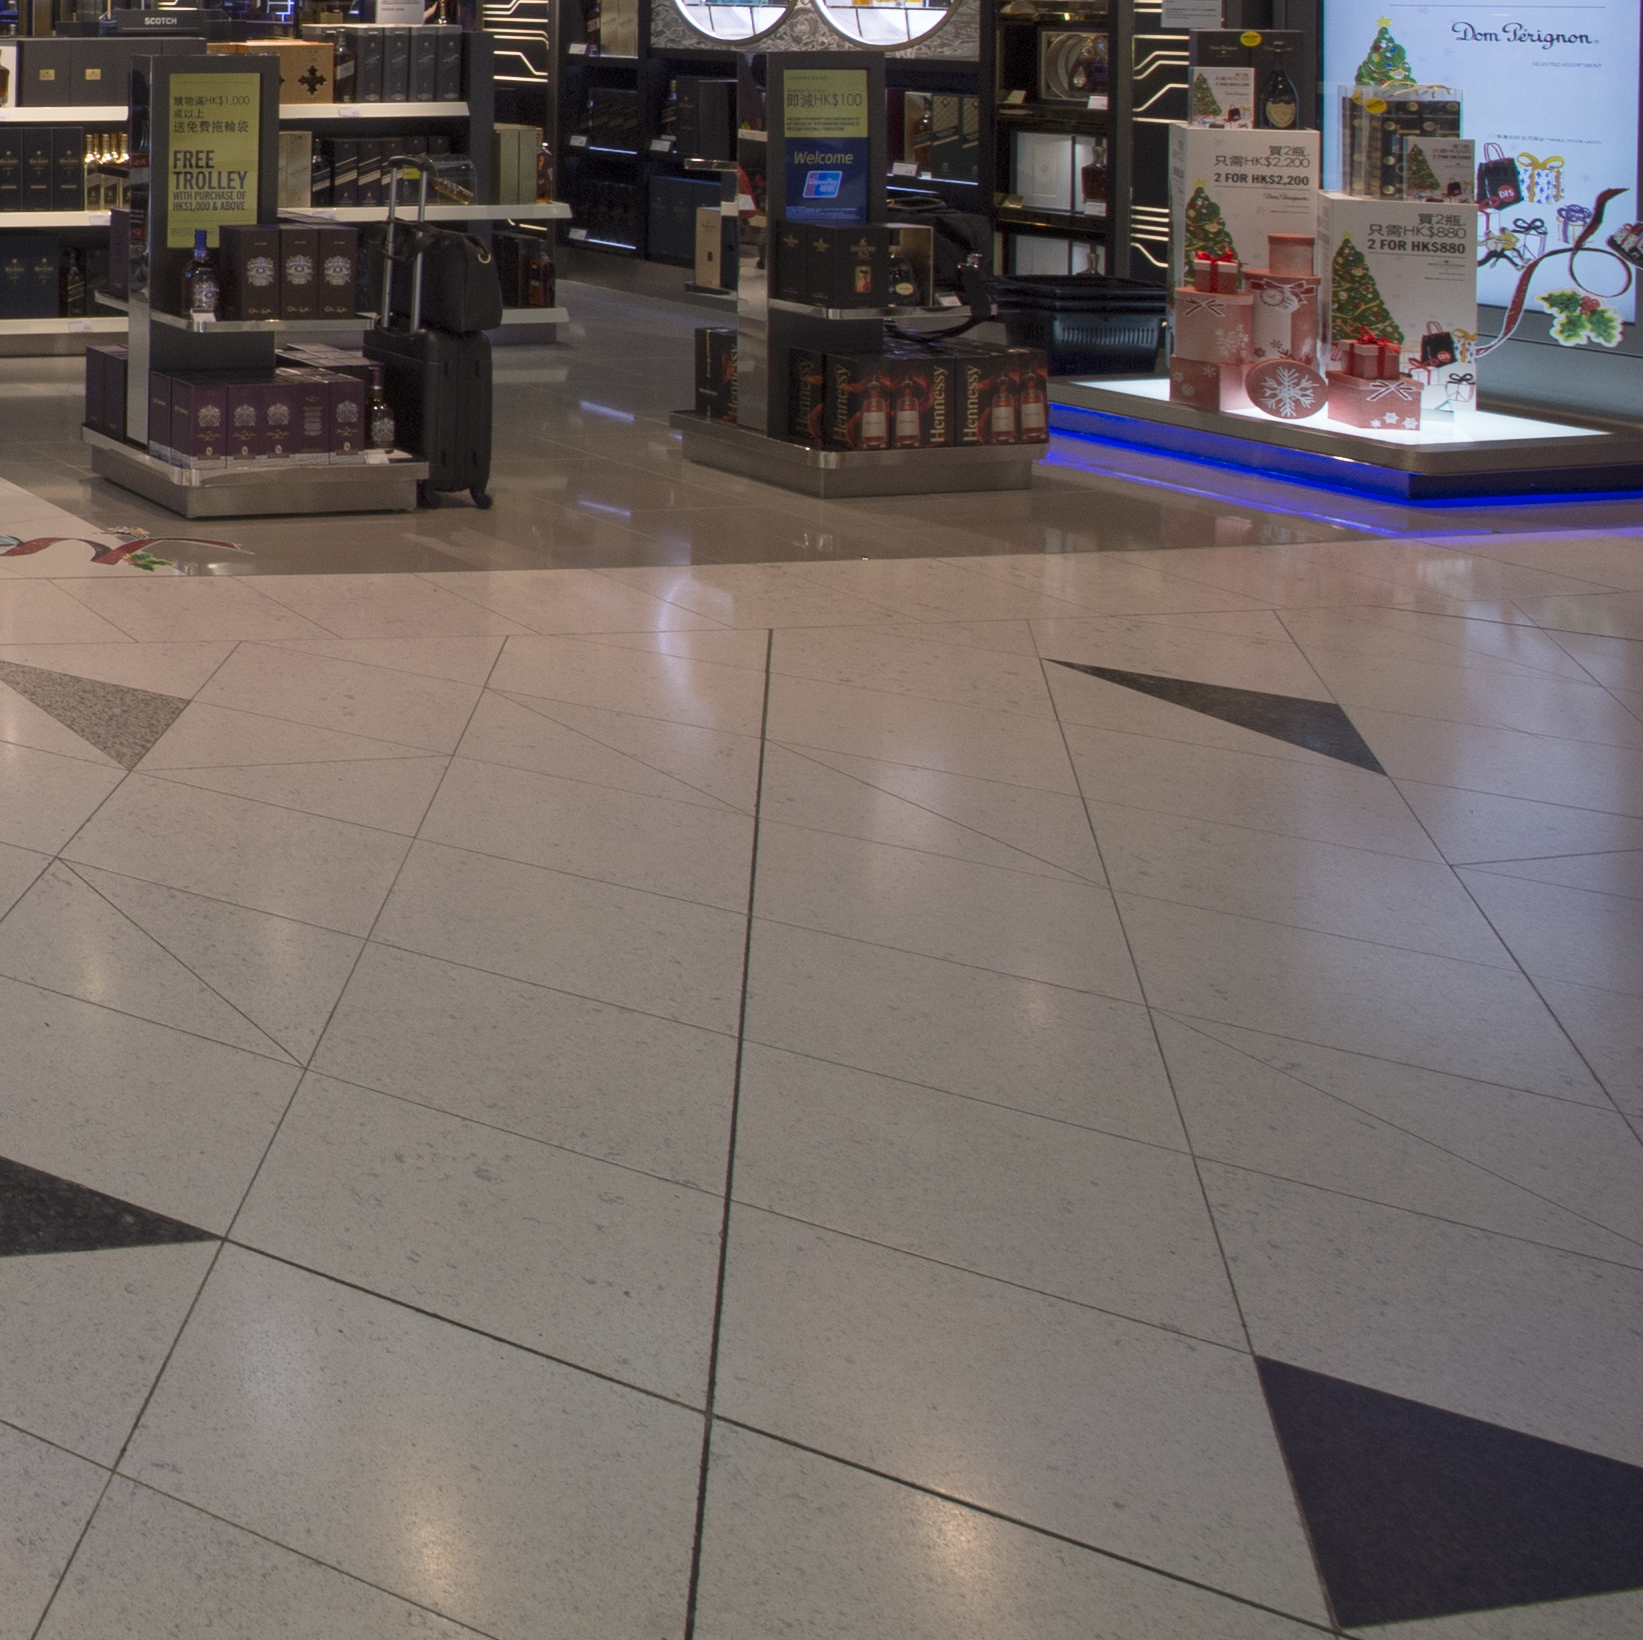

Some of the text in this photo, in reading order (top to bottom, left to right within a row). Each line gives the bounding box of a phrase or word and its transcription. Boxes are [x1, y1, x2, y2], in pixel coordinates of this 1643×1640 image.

[144, 17, 177, 25] SCOTCH
[1452, 21, 1592, 50] Dom Pérignon
[173, 150, 215, 169] FREE
[794, 150, 854, 165] Welcome
[173, 171, 248, 190] TROLLEY
[1214, 173, 1309, 186] 2 FOR HK$2,200
[173, 191, 246, 200] WITH PURCHASE OF
[173, 201, 211, 212] HK$1,000
[220, 201, 245, 211] ABOVE
[1367, 239, 1465, 254] 2 FOR HK$880
[832, 364, 851, 441] Hennessy
[930, 366, 948, 443] Hennessy
[963, 365, 980, 442] Hennessy
